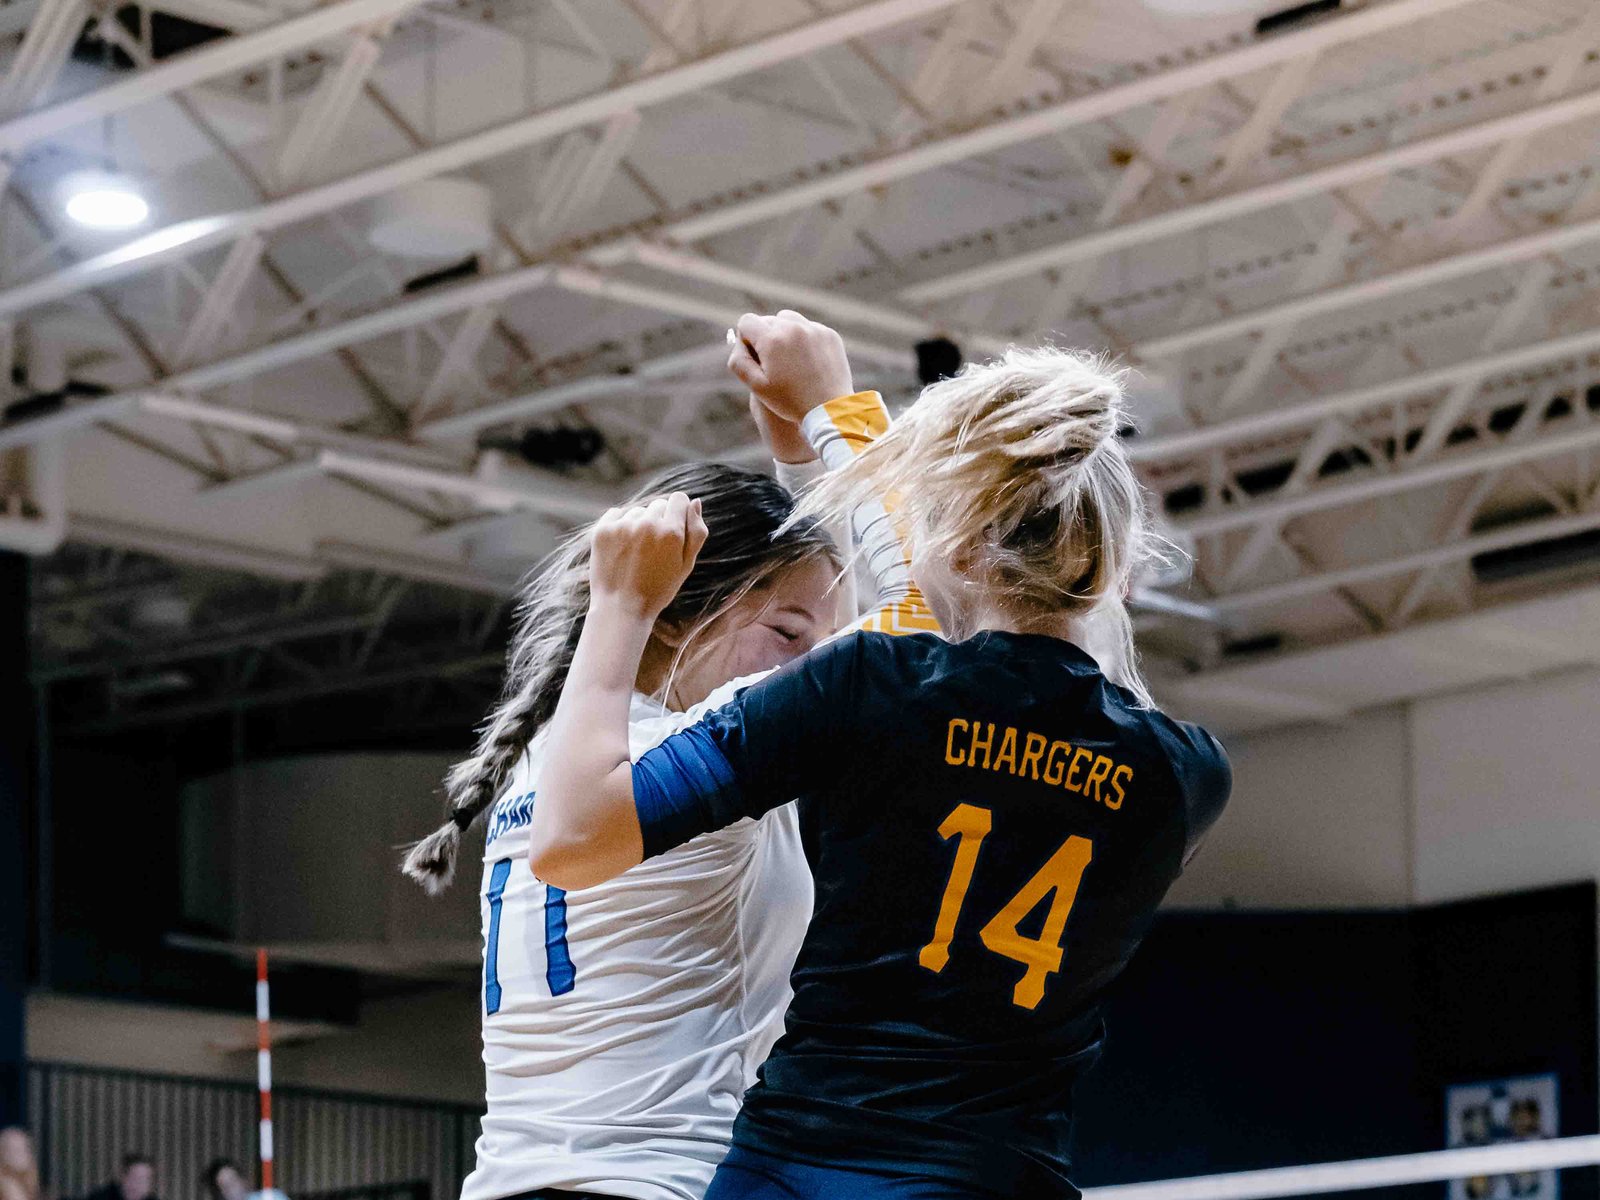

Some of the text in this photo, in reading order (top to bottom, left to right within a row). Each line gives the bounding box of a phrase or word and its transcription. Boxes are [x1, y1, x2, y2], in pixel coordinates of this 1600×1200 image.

[945, 718, 1134, 811] CHARGERS
[485, 857, 577, 1016] 11
[918, 802, 1093, 1010] 14
